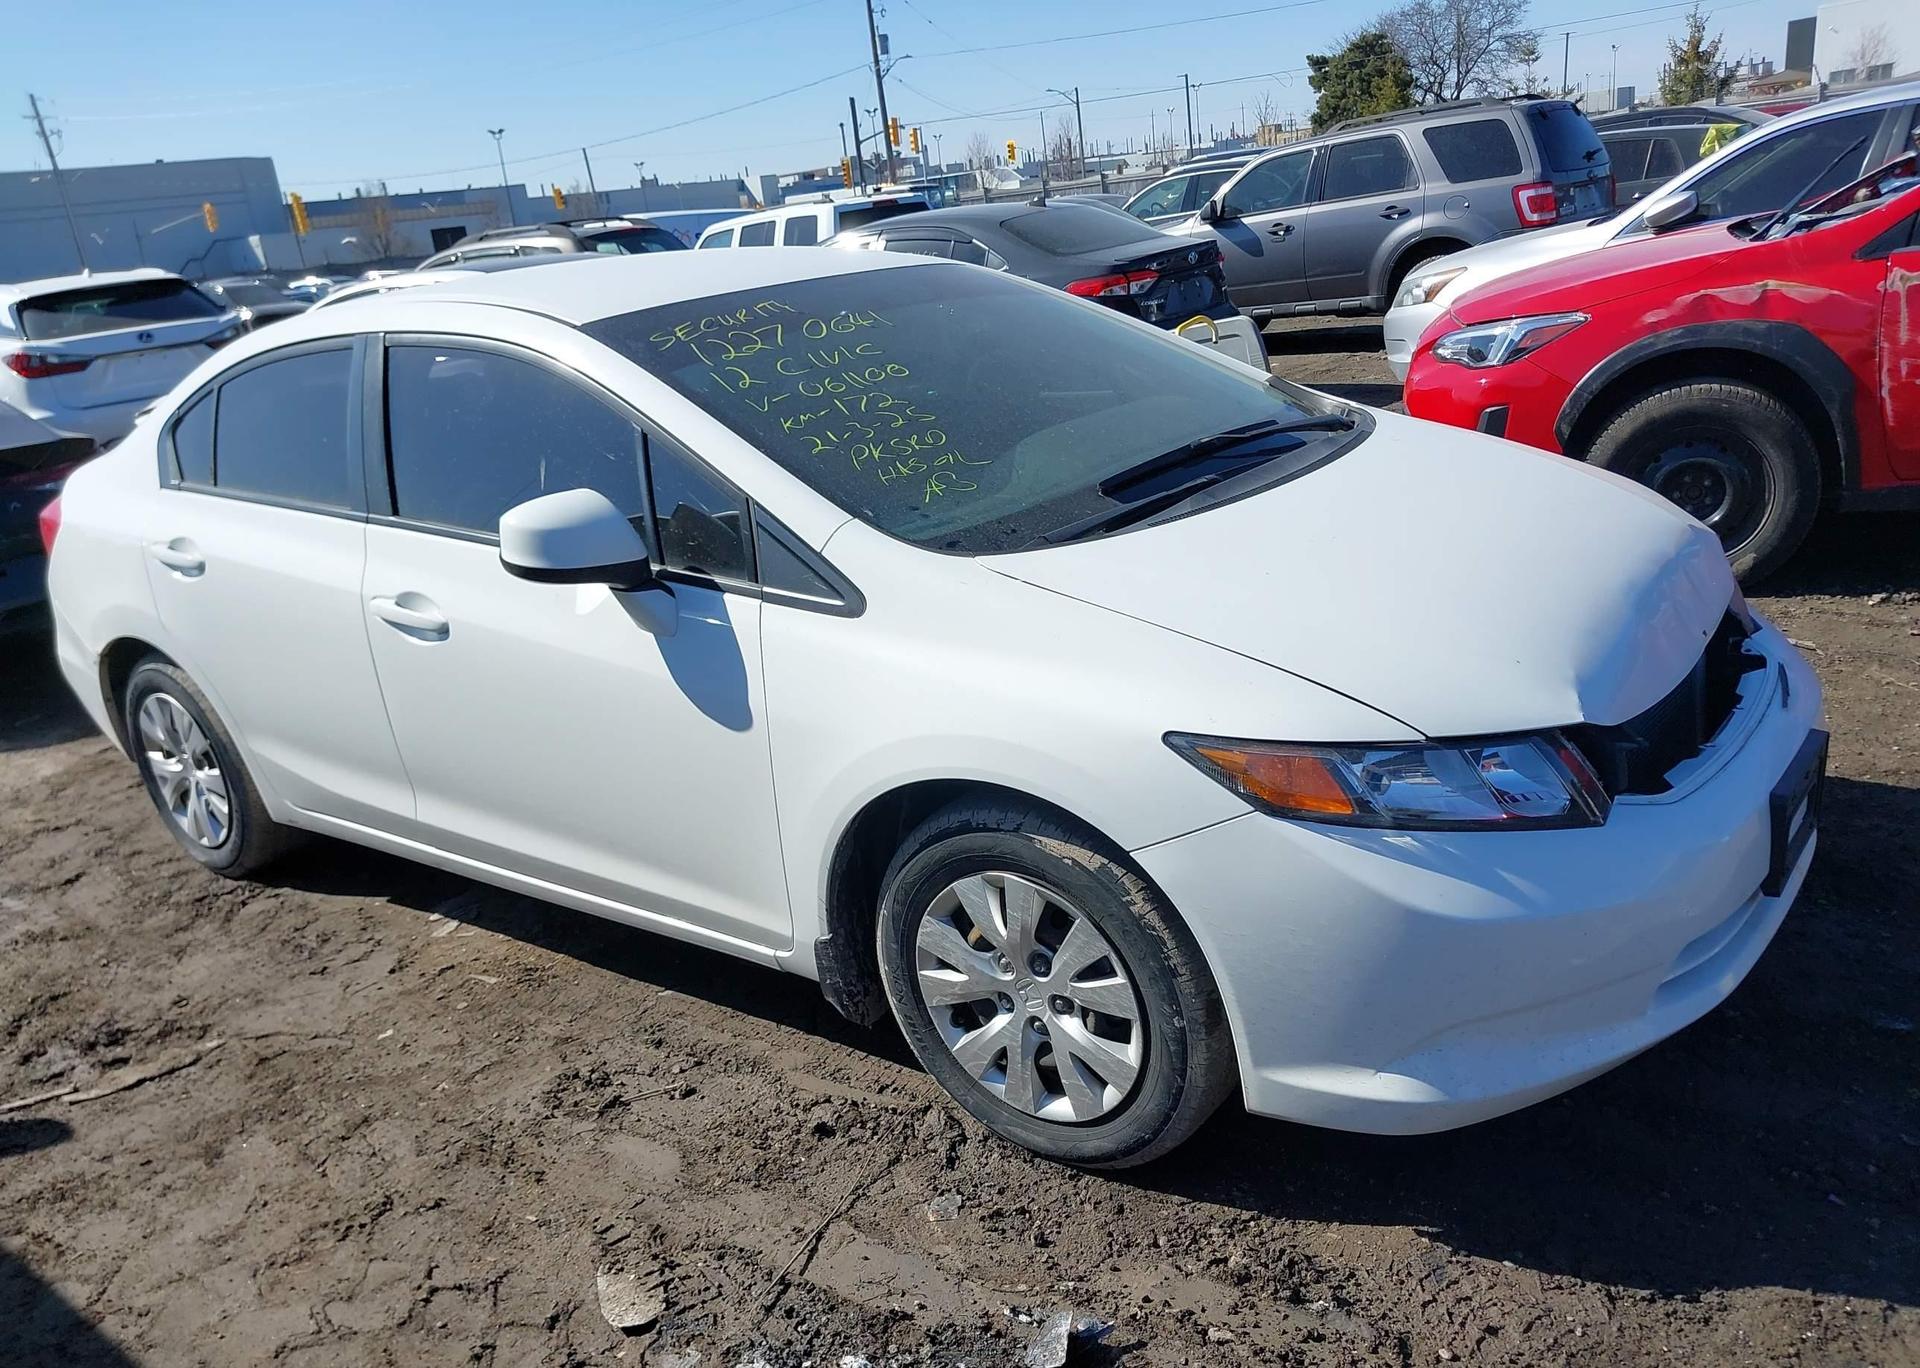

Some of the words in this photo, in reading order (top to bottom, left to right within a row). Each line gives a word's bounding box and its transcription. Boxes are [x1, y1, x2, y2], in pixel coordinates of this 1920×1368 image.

[690, 324, 784, 366] 1227
[803, 310, 894, 338] 0641
[710, 367, 769, 393] 12
[777, 344, 883, 375] CIVIC
